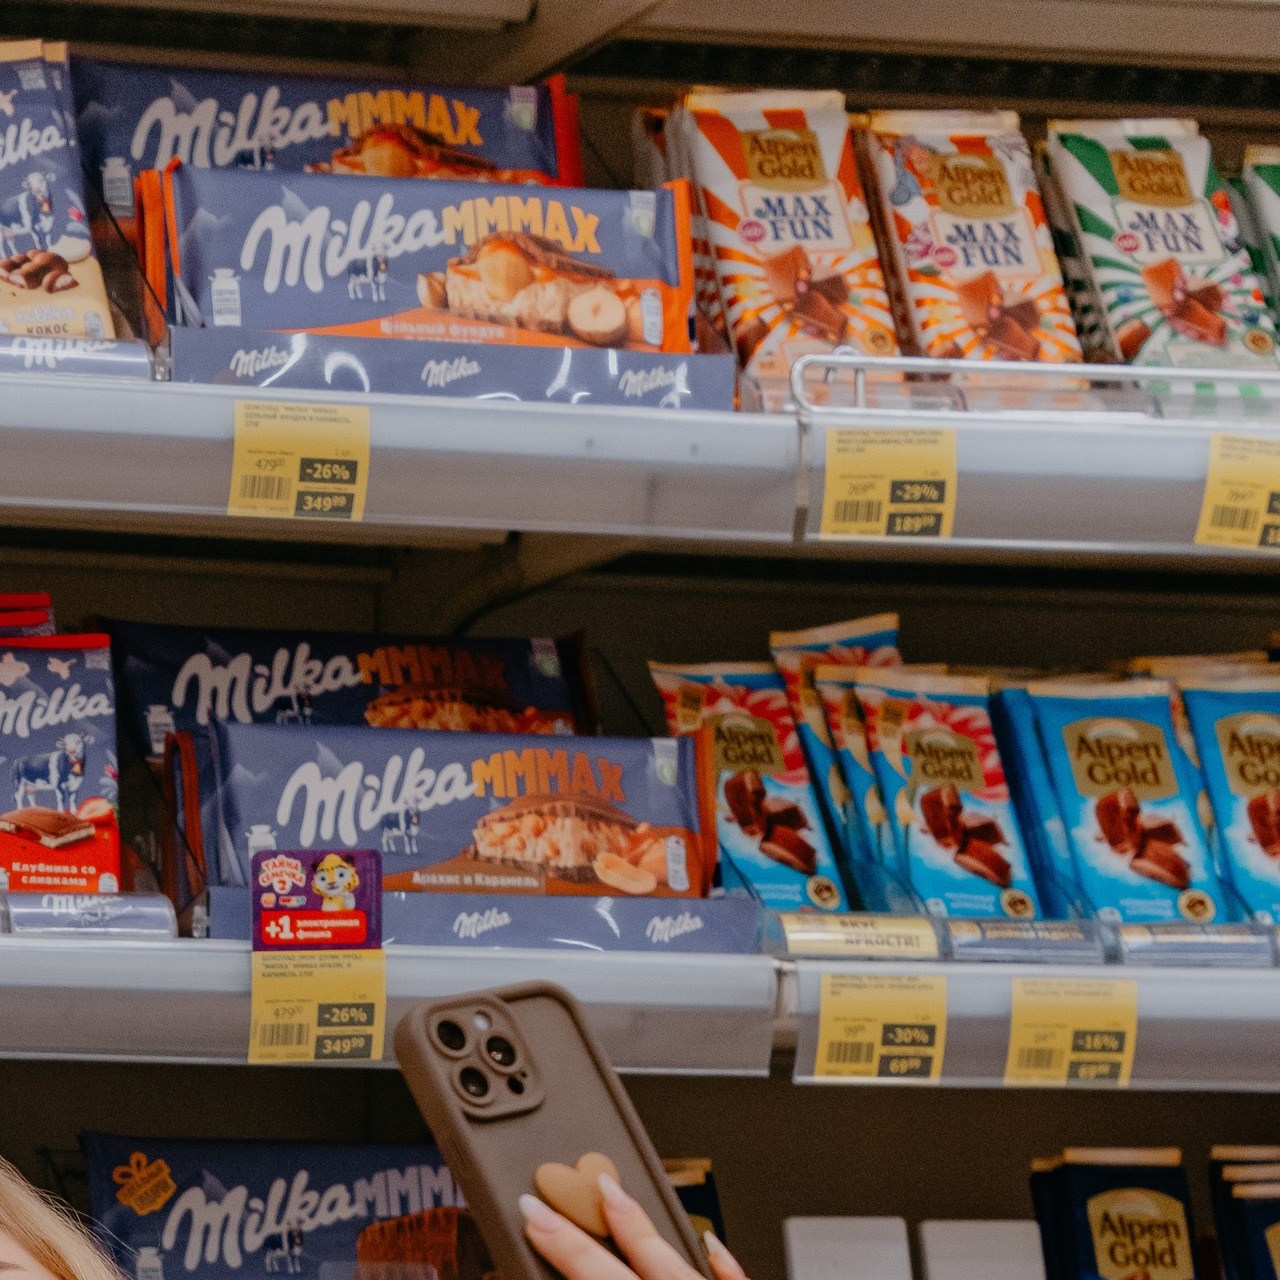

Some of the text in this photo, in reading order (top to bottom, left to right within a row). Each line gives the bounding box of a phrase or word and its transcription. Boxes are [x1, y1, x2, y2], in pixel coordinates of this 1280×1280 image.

[132, 86, 331, 164] Milka
[749, 133, 817, 160] Alpen
[758, 156, 816, 179] Gold
[754, 196, 832, 218] MAX
[770, 219, 834, 241] FUN
[947, 221, 1024, 245] MAX
[1129, 211, 1200, 232] MAX
[240, 194, 602, 294] Milka MMMAX
[1144, 232, 1205, 252] FUN
[962, 246, 1024, 267] FUN
[230, 346, 290, 378] Milka
[421, 357, 481, 387] Milka
[306, 463, 350, 480] -26%
[173, 643, 365, 724] Milka
[1076, 734, 1163, 763] Alpen
[1087, 760, 1160, 787] Gold
[277, 748, 625, 846] Milka MMMAX
[12, 861, 78, 874] Клубника
[21, 873, 88, 886] сливками
[277, 881, 288, 892] 2
[265, 915, 294, 940] +1
[453, 909, 512, 939] Milka
[646, 913, 704, 942] Milka
[323, 1006, 367, 1023] -26%
[163, 1170, 360, 1271] Milka
[1099, 1211, 1181, 1243] Alpen
[1109, 1239, 1177, 1269] Gold
